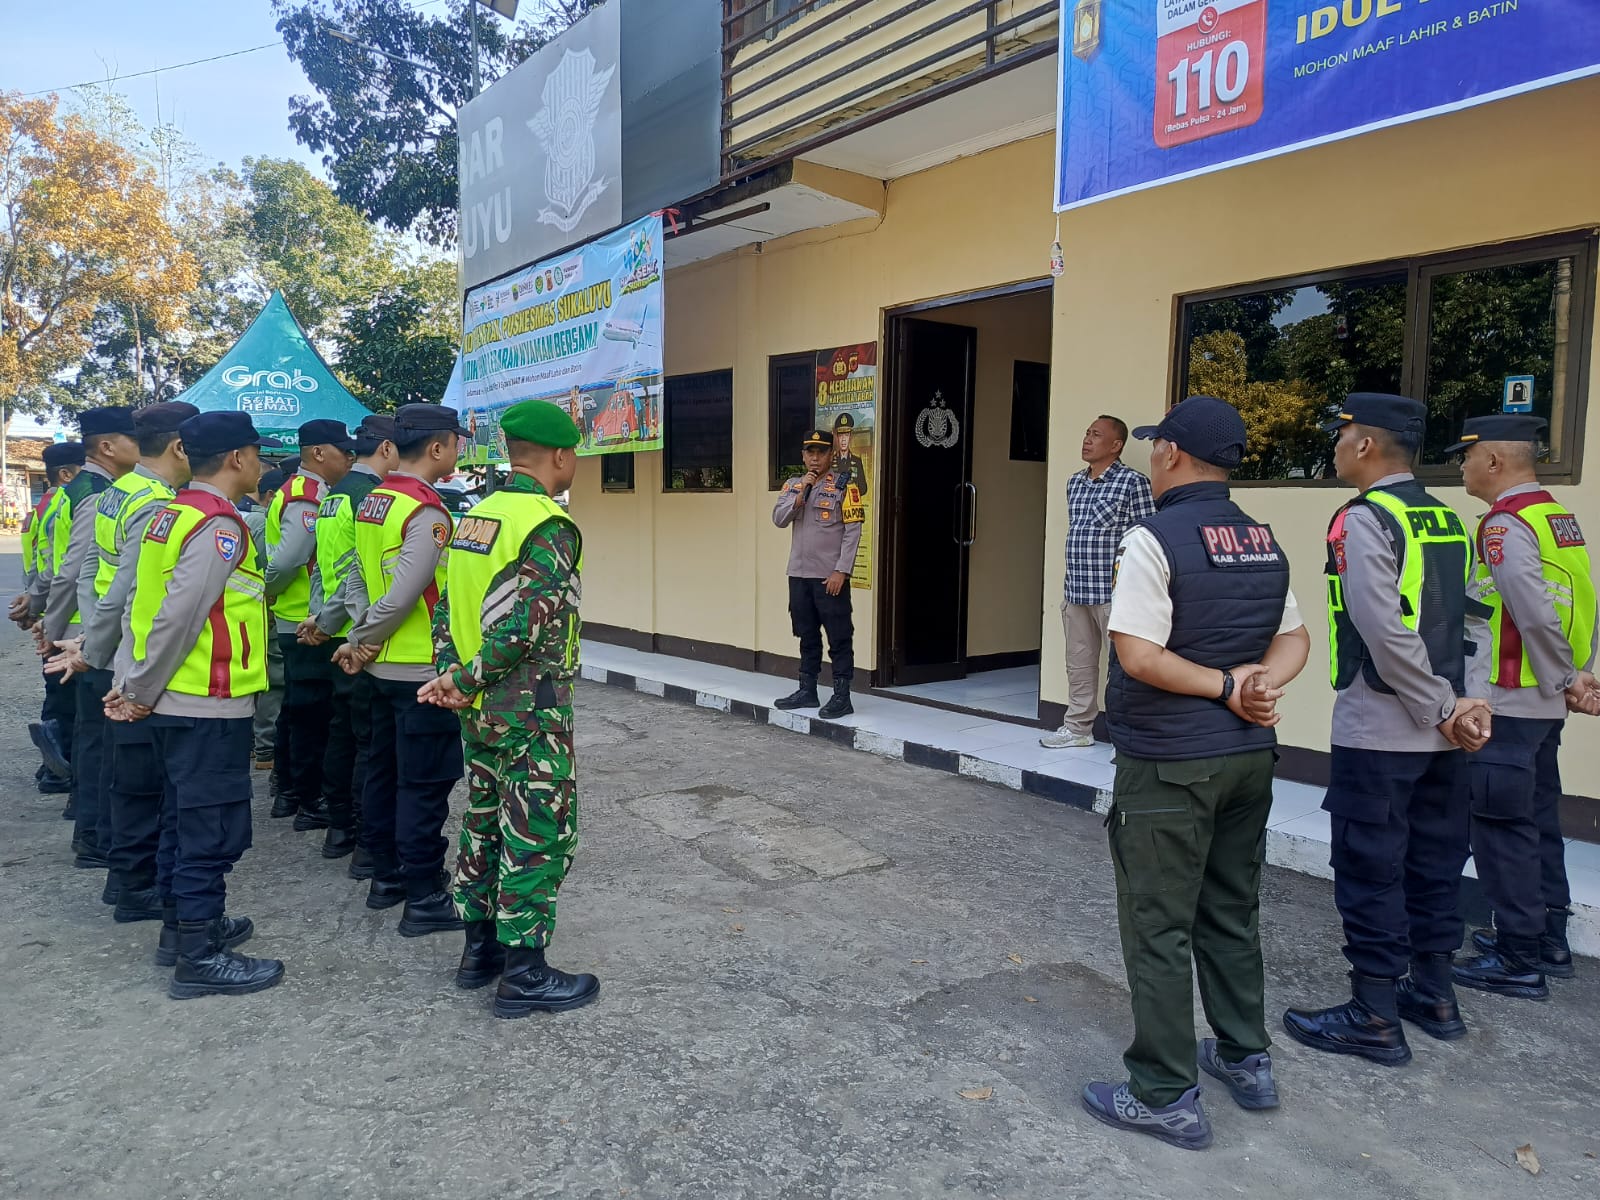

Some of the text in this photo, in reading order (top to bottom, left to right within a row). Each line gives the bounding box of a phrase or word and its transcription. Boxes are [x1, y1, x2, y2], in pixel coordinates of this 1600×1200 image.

[1167, 3, 1196, 20] DALAM
[1186, 30, 1232, 52] HUBUNGI:
[1293, 0, 1518, 78] MOHON MAAF LAHIR & BATIN
[1168, 40, 1249, 117] 110
[1164, 119, 1189, 134] (Bebas
[1190, 113, 1211, 126] Pulsa
[1216, 109, 1227, 119] 24
[1228, 102, 1247, 115] Jam)
[501, 299, 555, 340] PUSKESMAS
[557, 279, 613, 322] SUKALUYU
[554, 321, 599, 357] BERSAMA
[222, 365, 319, 393] Grab
[242, 402, 297, 412] HEMAT
[818, 381, 828, 407] 8
[1212, 553, 1279, 563] KAB. CIANJUR
